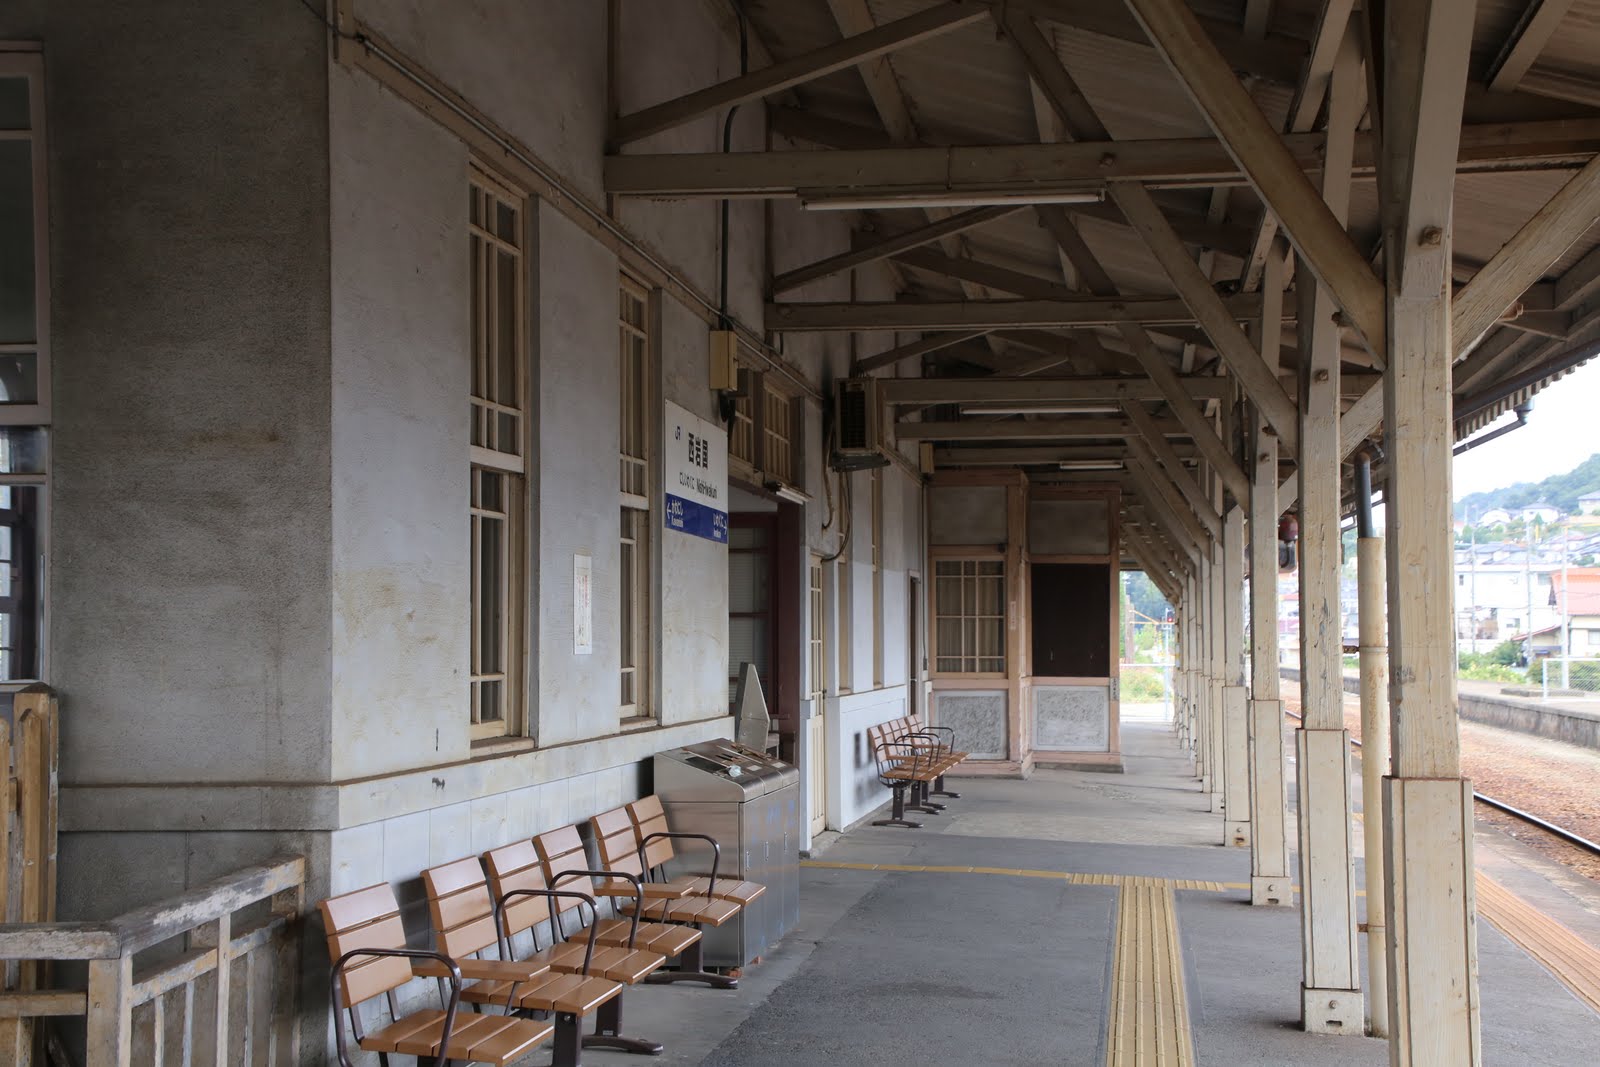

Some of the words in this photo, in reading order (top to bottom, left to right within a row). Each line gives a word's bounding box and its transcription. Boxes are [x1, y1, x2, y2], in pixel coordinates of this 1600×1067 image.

[675, 426, 681, 440] JR
[688, 432, 709, 469] 西岩国
